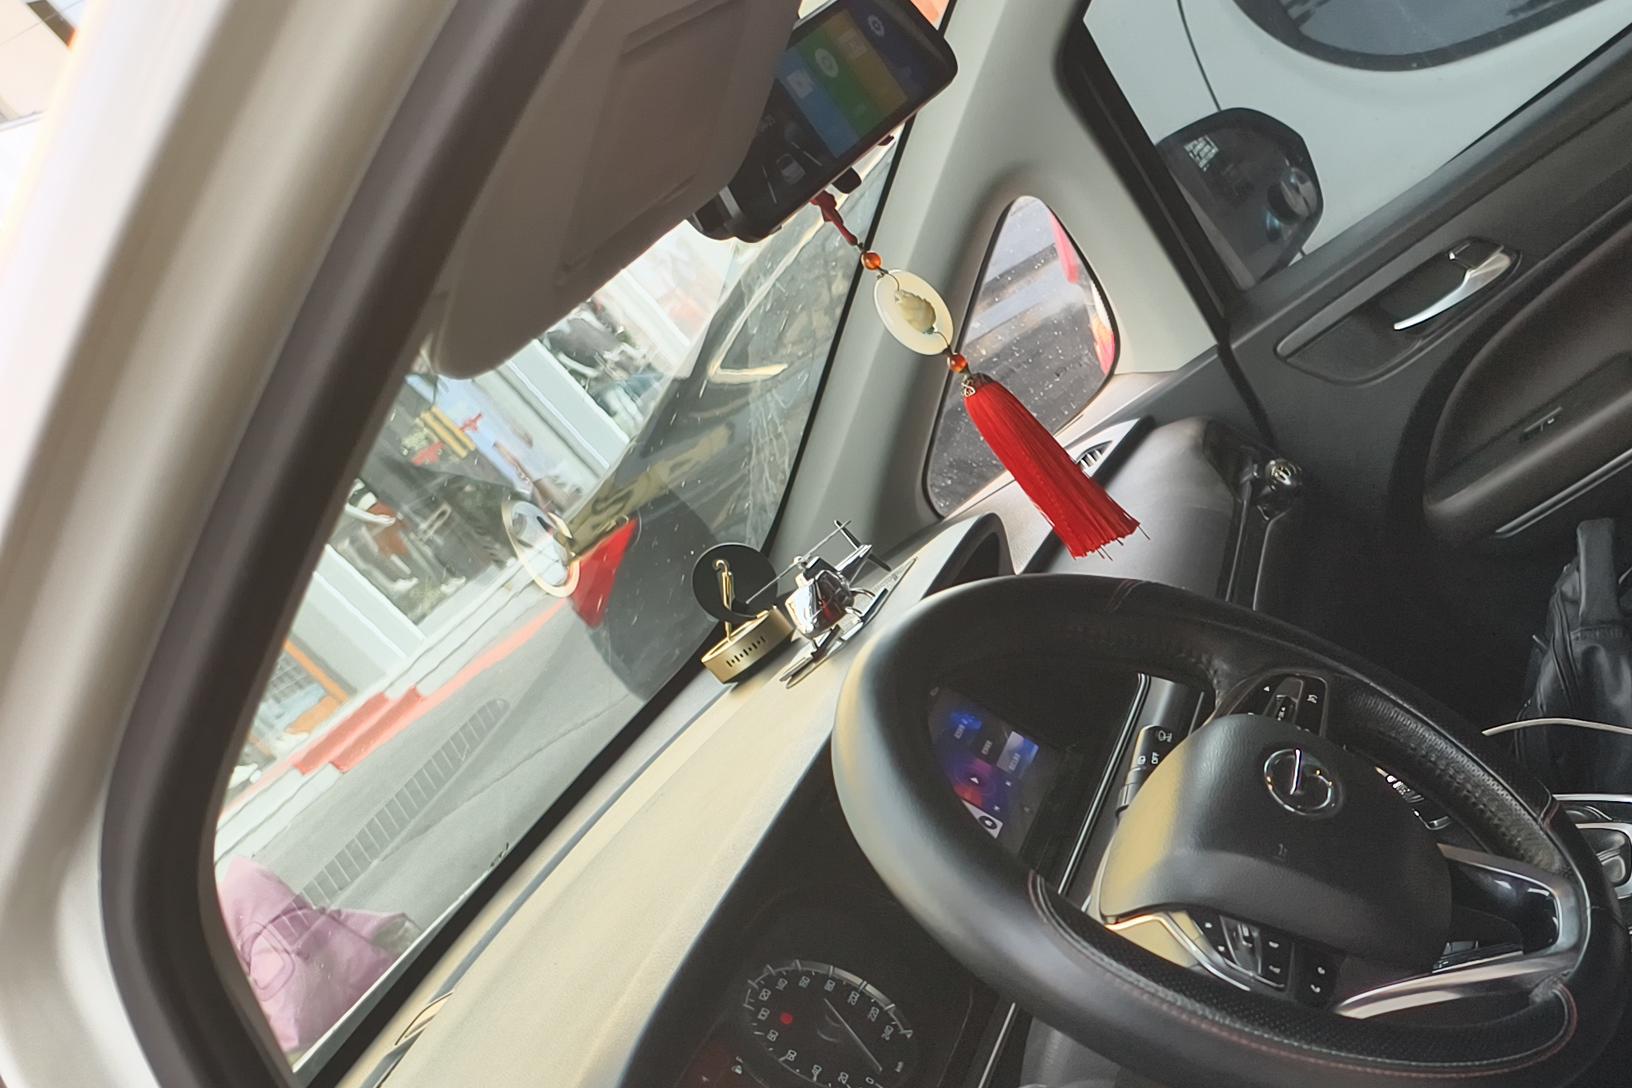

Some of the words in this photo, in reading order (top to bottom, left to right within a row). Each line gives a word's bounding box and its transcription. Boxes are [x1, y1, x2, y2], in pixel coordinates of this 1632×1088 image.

[848, 991, 860, 1006] 200
[757, 1007, 770, 1021] 100
[766, 1029, 779, 1042] 80
[785, 1050, 797, 1062] 60
[837, 1071, 849, 1084] 20
[865, 1076, 875, 1085] 0
